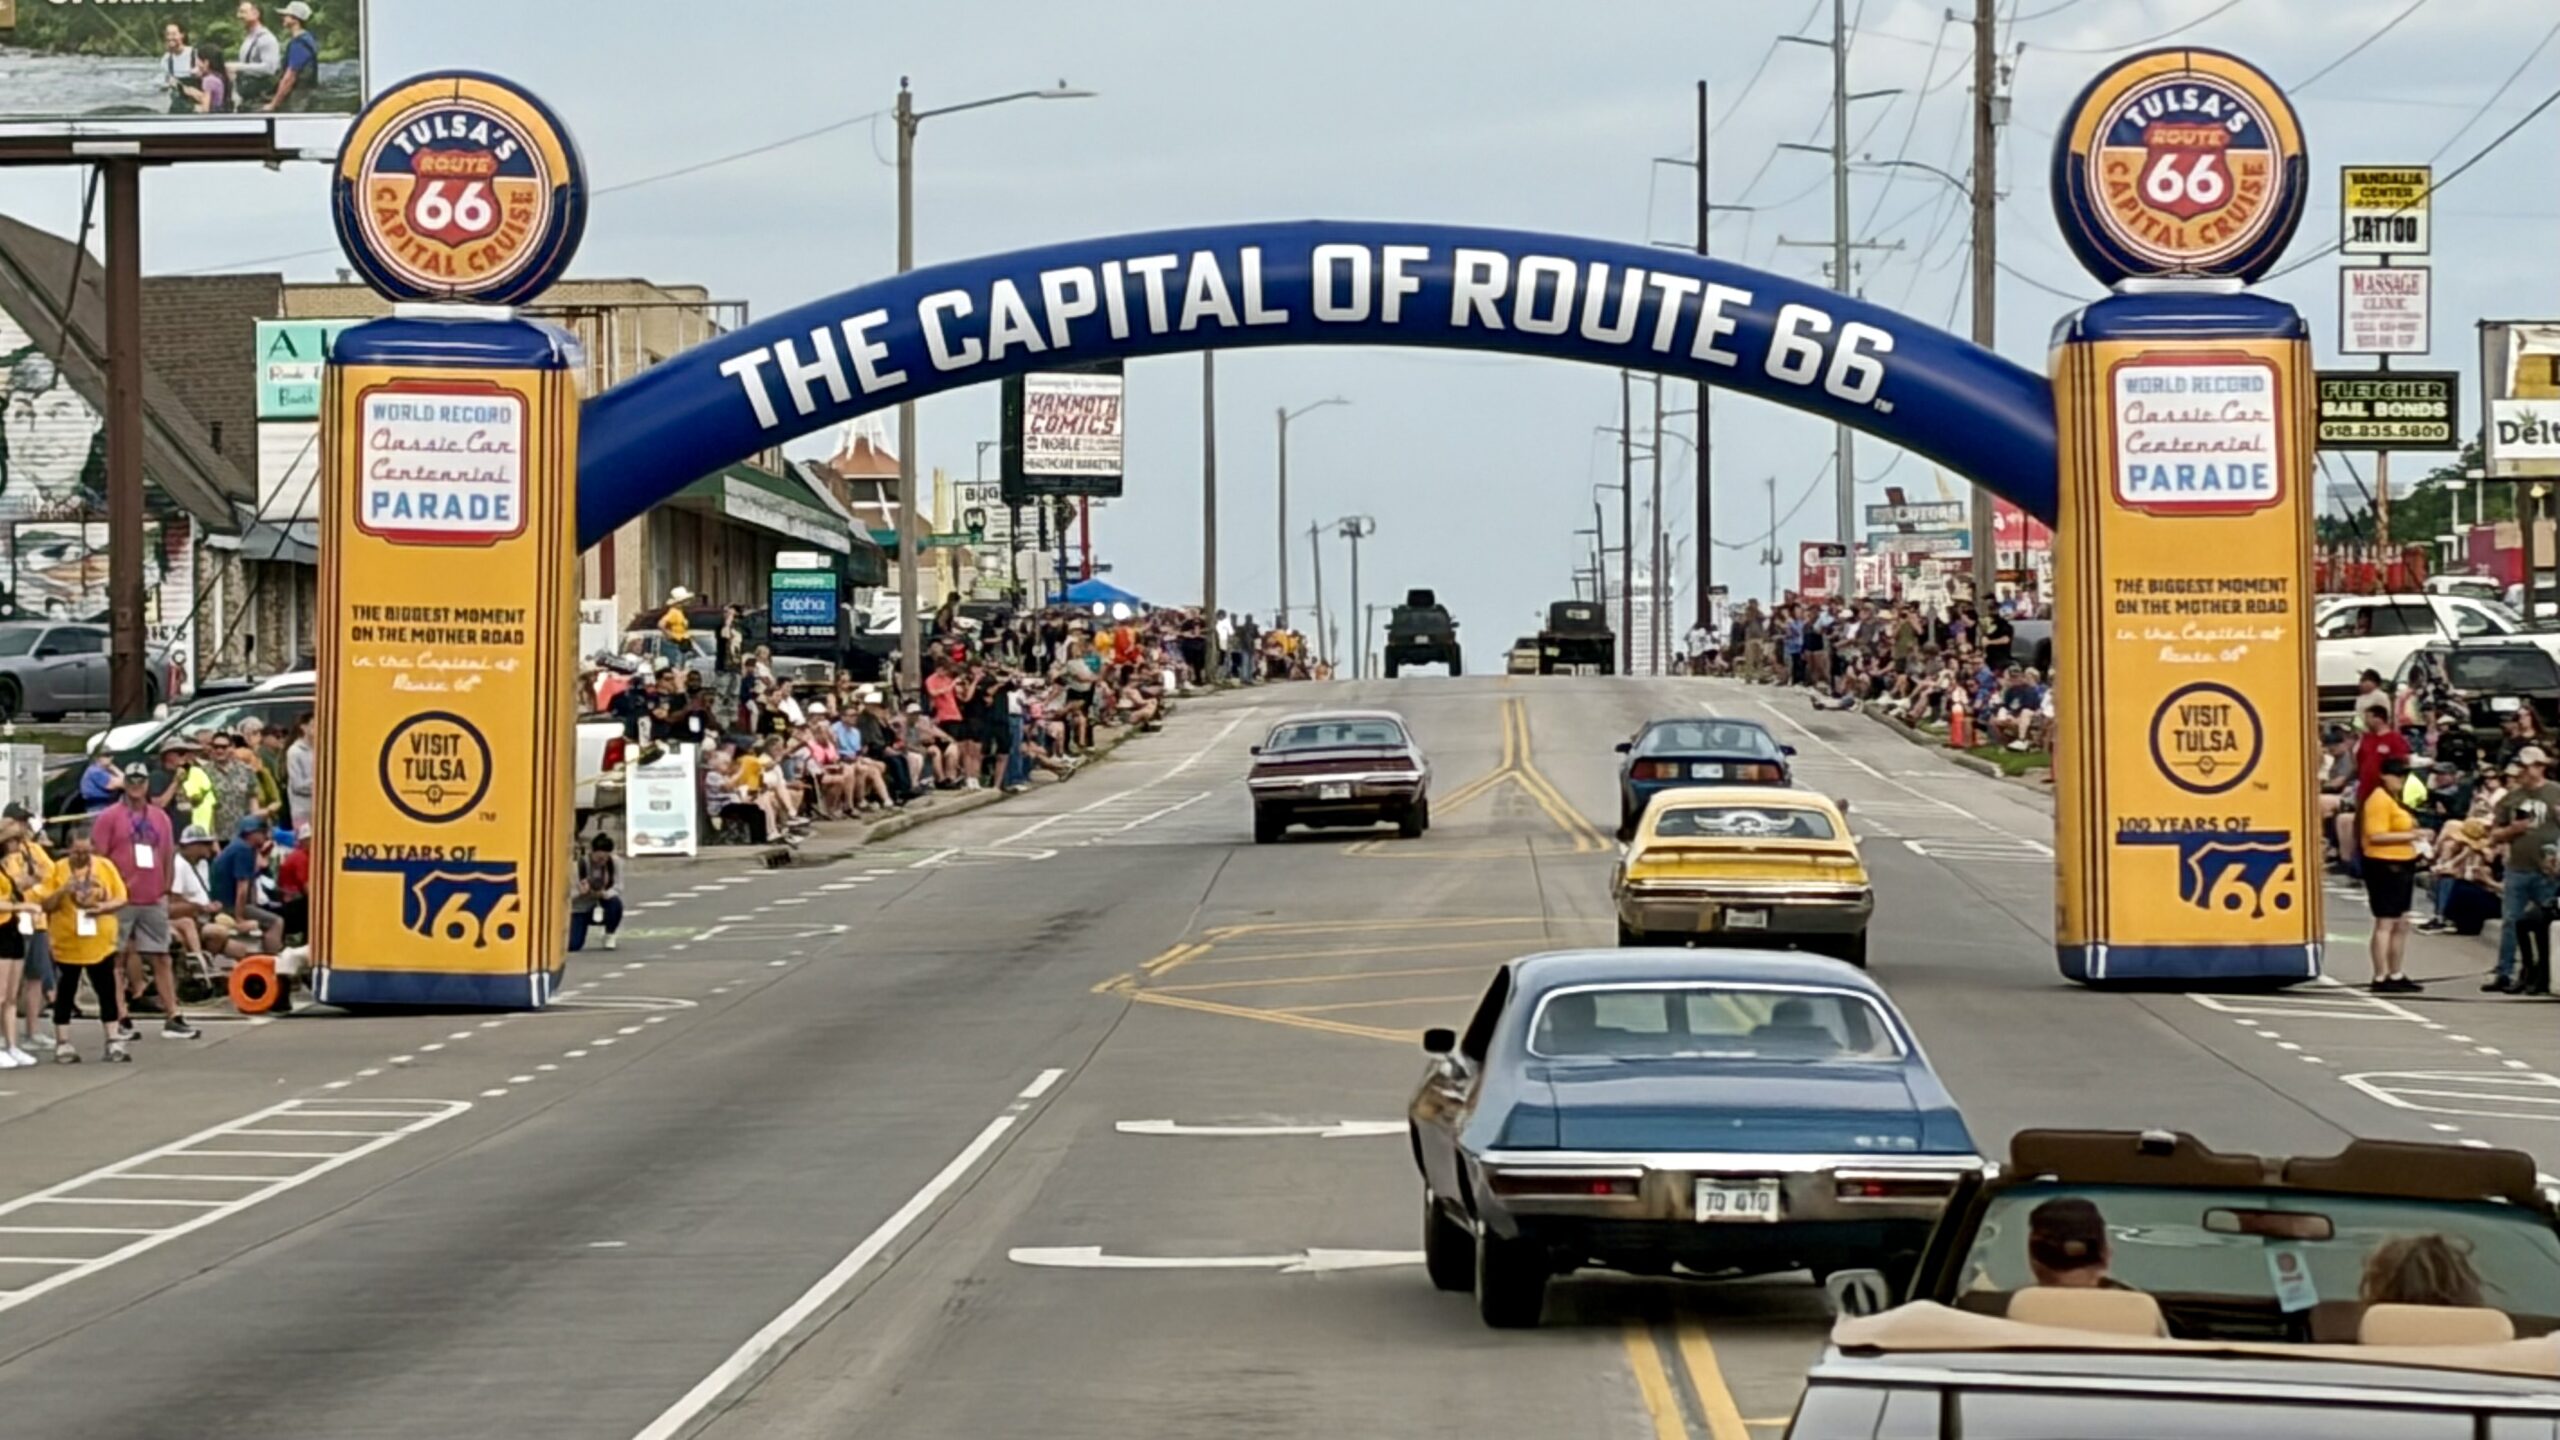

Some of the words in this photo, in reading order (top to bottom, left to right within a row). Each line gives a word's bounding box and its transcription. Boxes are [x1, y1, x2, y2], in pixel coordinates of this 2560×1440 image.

[2124, 88, 2250, 133] TULSA'S
[393, 115, 518, 161] TULSA'S
[2151, 129, 2222, 146] ROUTE
[420, 156, 490, 173] ROUTE
[2146, 153, 2224, 204] 66
[2350, 172, 2424, 185] VANDALIA
[2360, 187, 2414, 198] CENTER
[415, 180, 492, 232] 66
[2107, 161, 2190, 248] CAPITAL
[2199, 161, 2265, 245] CRUISE
[376, 187, 456, 276] CAPITAL
[468, 190, 534, 272] CRUISE
[2352, 216, 2418, 243] TATTOO
[2352, 273, 2421, 296] MASSAGE
[719, 308, 908, 430] THE
[917, 247, 1289, 372] CAPITAL
[1312, 244, 1430, 324] OF
[1450, 248, 1754, 368] ROUTE
[1764, 303, 1895, 406] 66
[2125, 377, 2187, 394] WORLD
[2192, 376, 2265, 394] RECORD
[2321, 381, 2447, 400] FLETCHER
[372, 404, 435, 422] WORLD
[440, 405, 512, 424] RECORD
[1028, 392, 1120, 418] MAMMOTH
[2124, 400, 2220, 424] Classic
[2221, 400, 2271, 423] Car
[2321, 401, 2370, 417] BAIL
[2373, 401, 2447, 417] BONDS
[1031, 414, 1115, 435] COMICS
[370, 427, 464, 452] Classic
[466, 429, 516, 454] Car
[1041, 438, 1080, 451] NOBLE
[2125, 430, 2267, 454] Centennial
[370, 457, 512, 484] Centennial
[2128, 463, 2269, 491] PARADE
[372, 491, 511, 521] PARADE
[2115, 578, 2146, 593] THE
[2149, 578, 2214, 594] BIGGEST
[2217, 577, 2289, 593] MOMENT
[352, 605, 381, 621] THE
[385, 606, 450, 623] BIGGEST
[454, 608, 526, 624] MOMENT
[781, 596, 826, 614] alpha
[2116, 599, 2137, 614] ON
[2141, 599, 2171, 614] THE
[2175, 599, 2242, 614] MOTHER
[2246, 599, 2288, 614] ROAD
[351, 626, 374, 642] ON
[377, 627, 407, 643] THE
[411, 628, 477, 644] MOTHER
[481, 629, 525, 645] ROAD
[2116, 626, 2138, 640] in
[2144, 625, 2179, 640] the
[2181, 620, 2256, 644] Capital
[416, 650, 492, 671] Capital
[2158, 644, 2217, 663] Route
[2178, 704, 2231, 727] VISIT
[410, 732, 461, 757] VISIT
[2173, 729, 2239, 753] TULSA
[403, 758, 467, 781] TULSA
[2117, 816, 2150, 833] 100
[2155, 816, 2219, 833] YEARS
[2223, 817, 2252, 833] OF
[344, 843, 377, 860] 100
[382, 844, 444, 861] YEARS
[449, 846, 477, 863] OF
[2208, 862, 2297, 918] 66
[431, 892, 522, 946] 66
